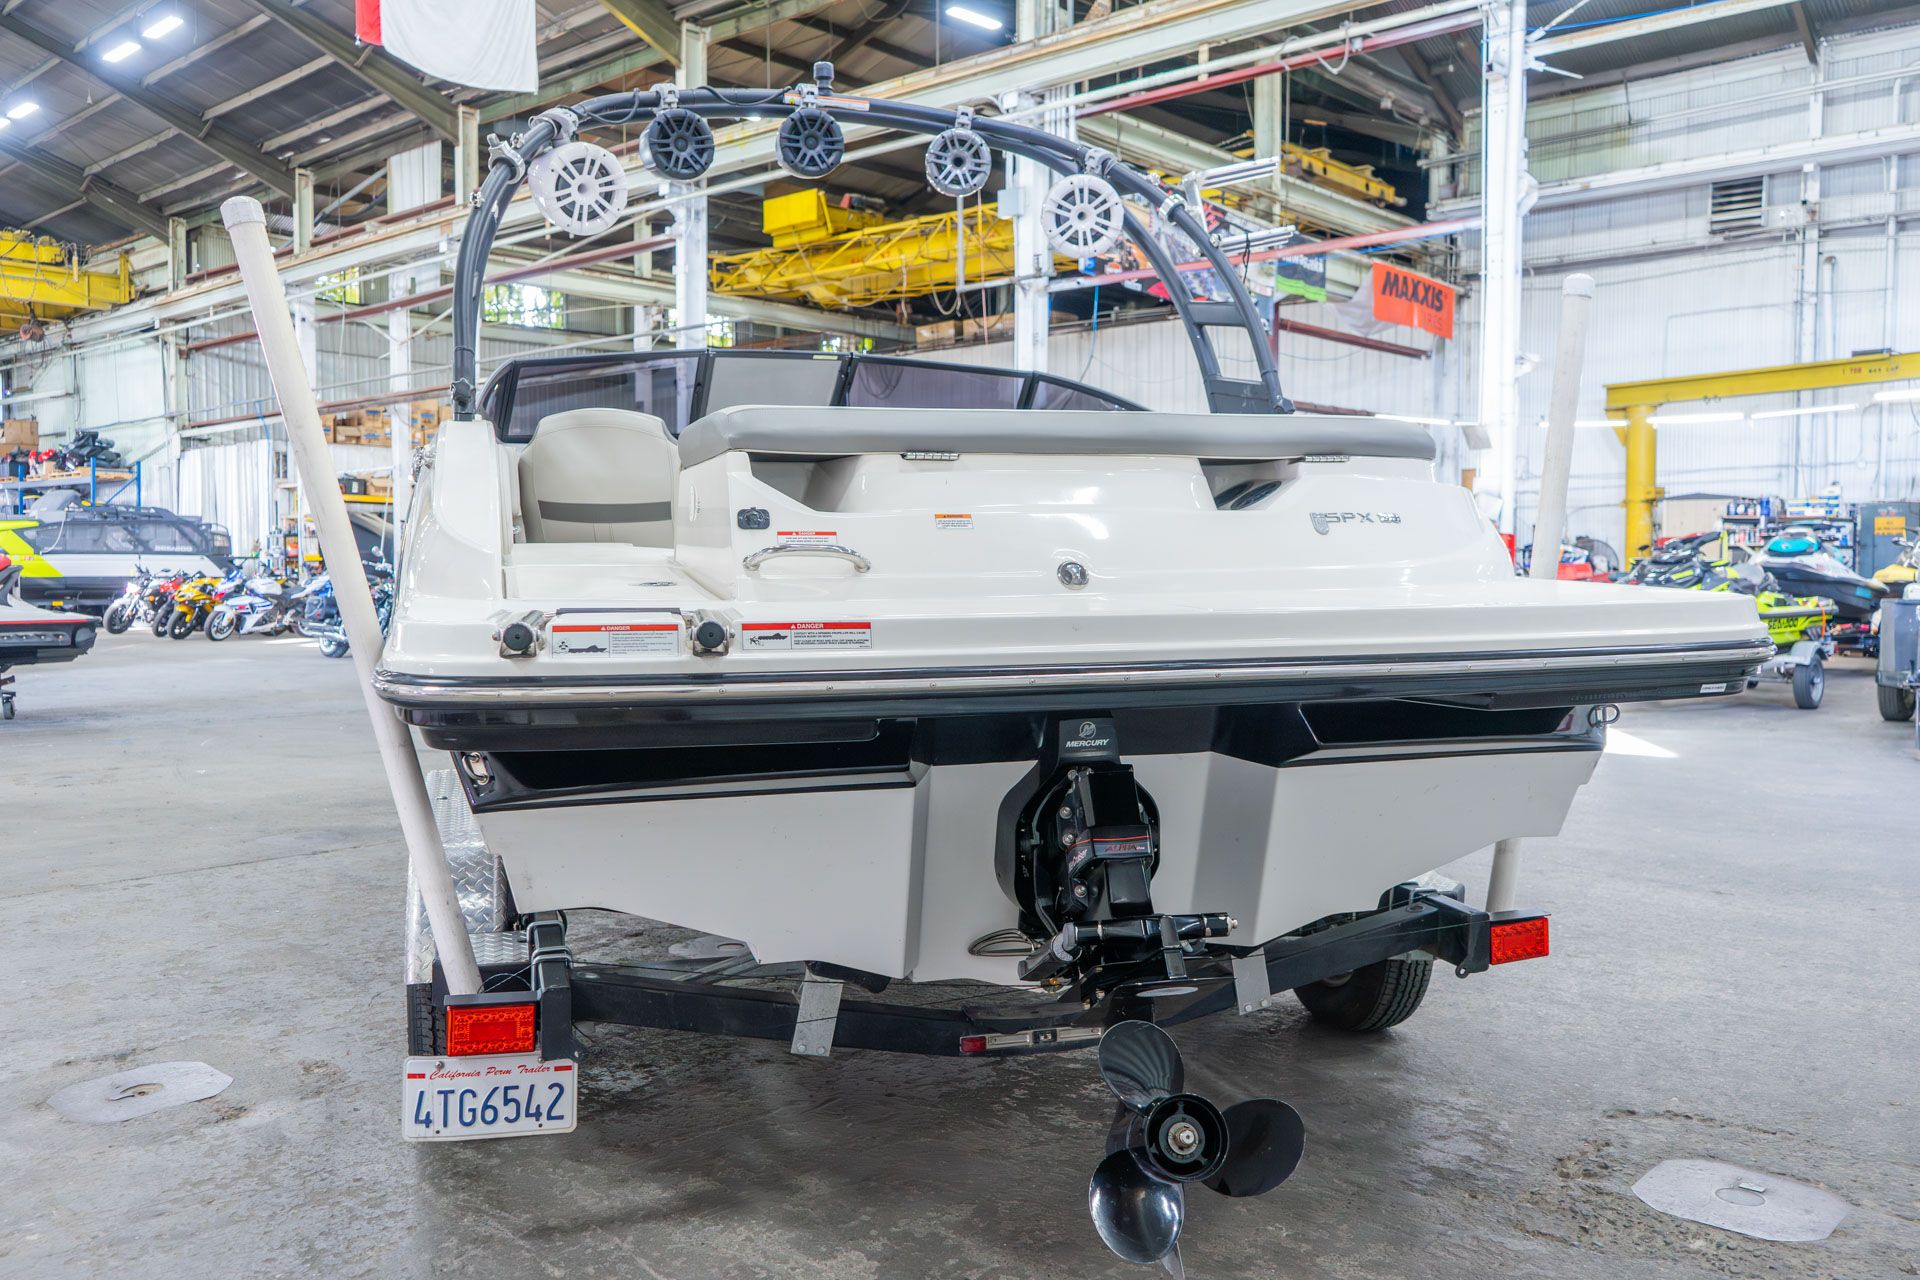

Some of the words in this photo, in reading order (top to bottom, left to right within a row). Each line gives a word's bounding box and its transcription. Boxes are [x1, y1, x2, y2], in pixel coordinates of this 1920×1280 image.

[1381, 271, 1444, 312] MAXXIS
[1325, 512, 1374, 523] SPX
[1065, 738, 1110, 748] MERCURY
[429, 1069, 481, 1081] California
[485, 1066, 513, 1076] Perm
[517, 1064, 551, 1075] Trailer
[414, 1082, 565, 1129] 4TG6542
